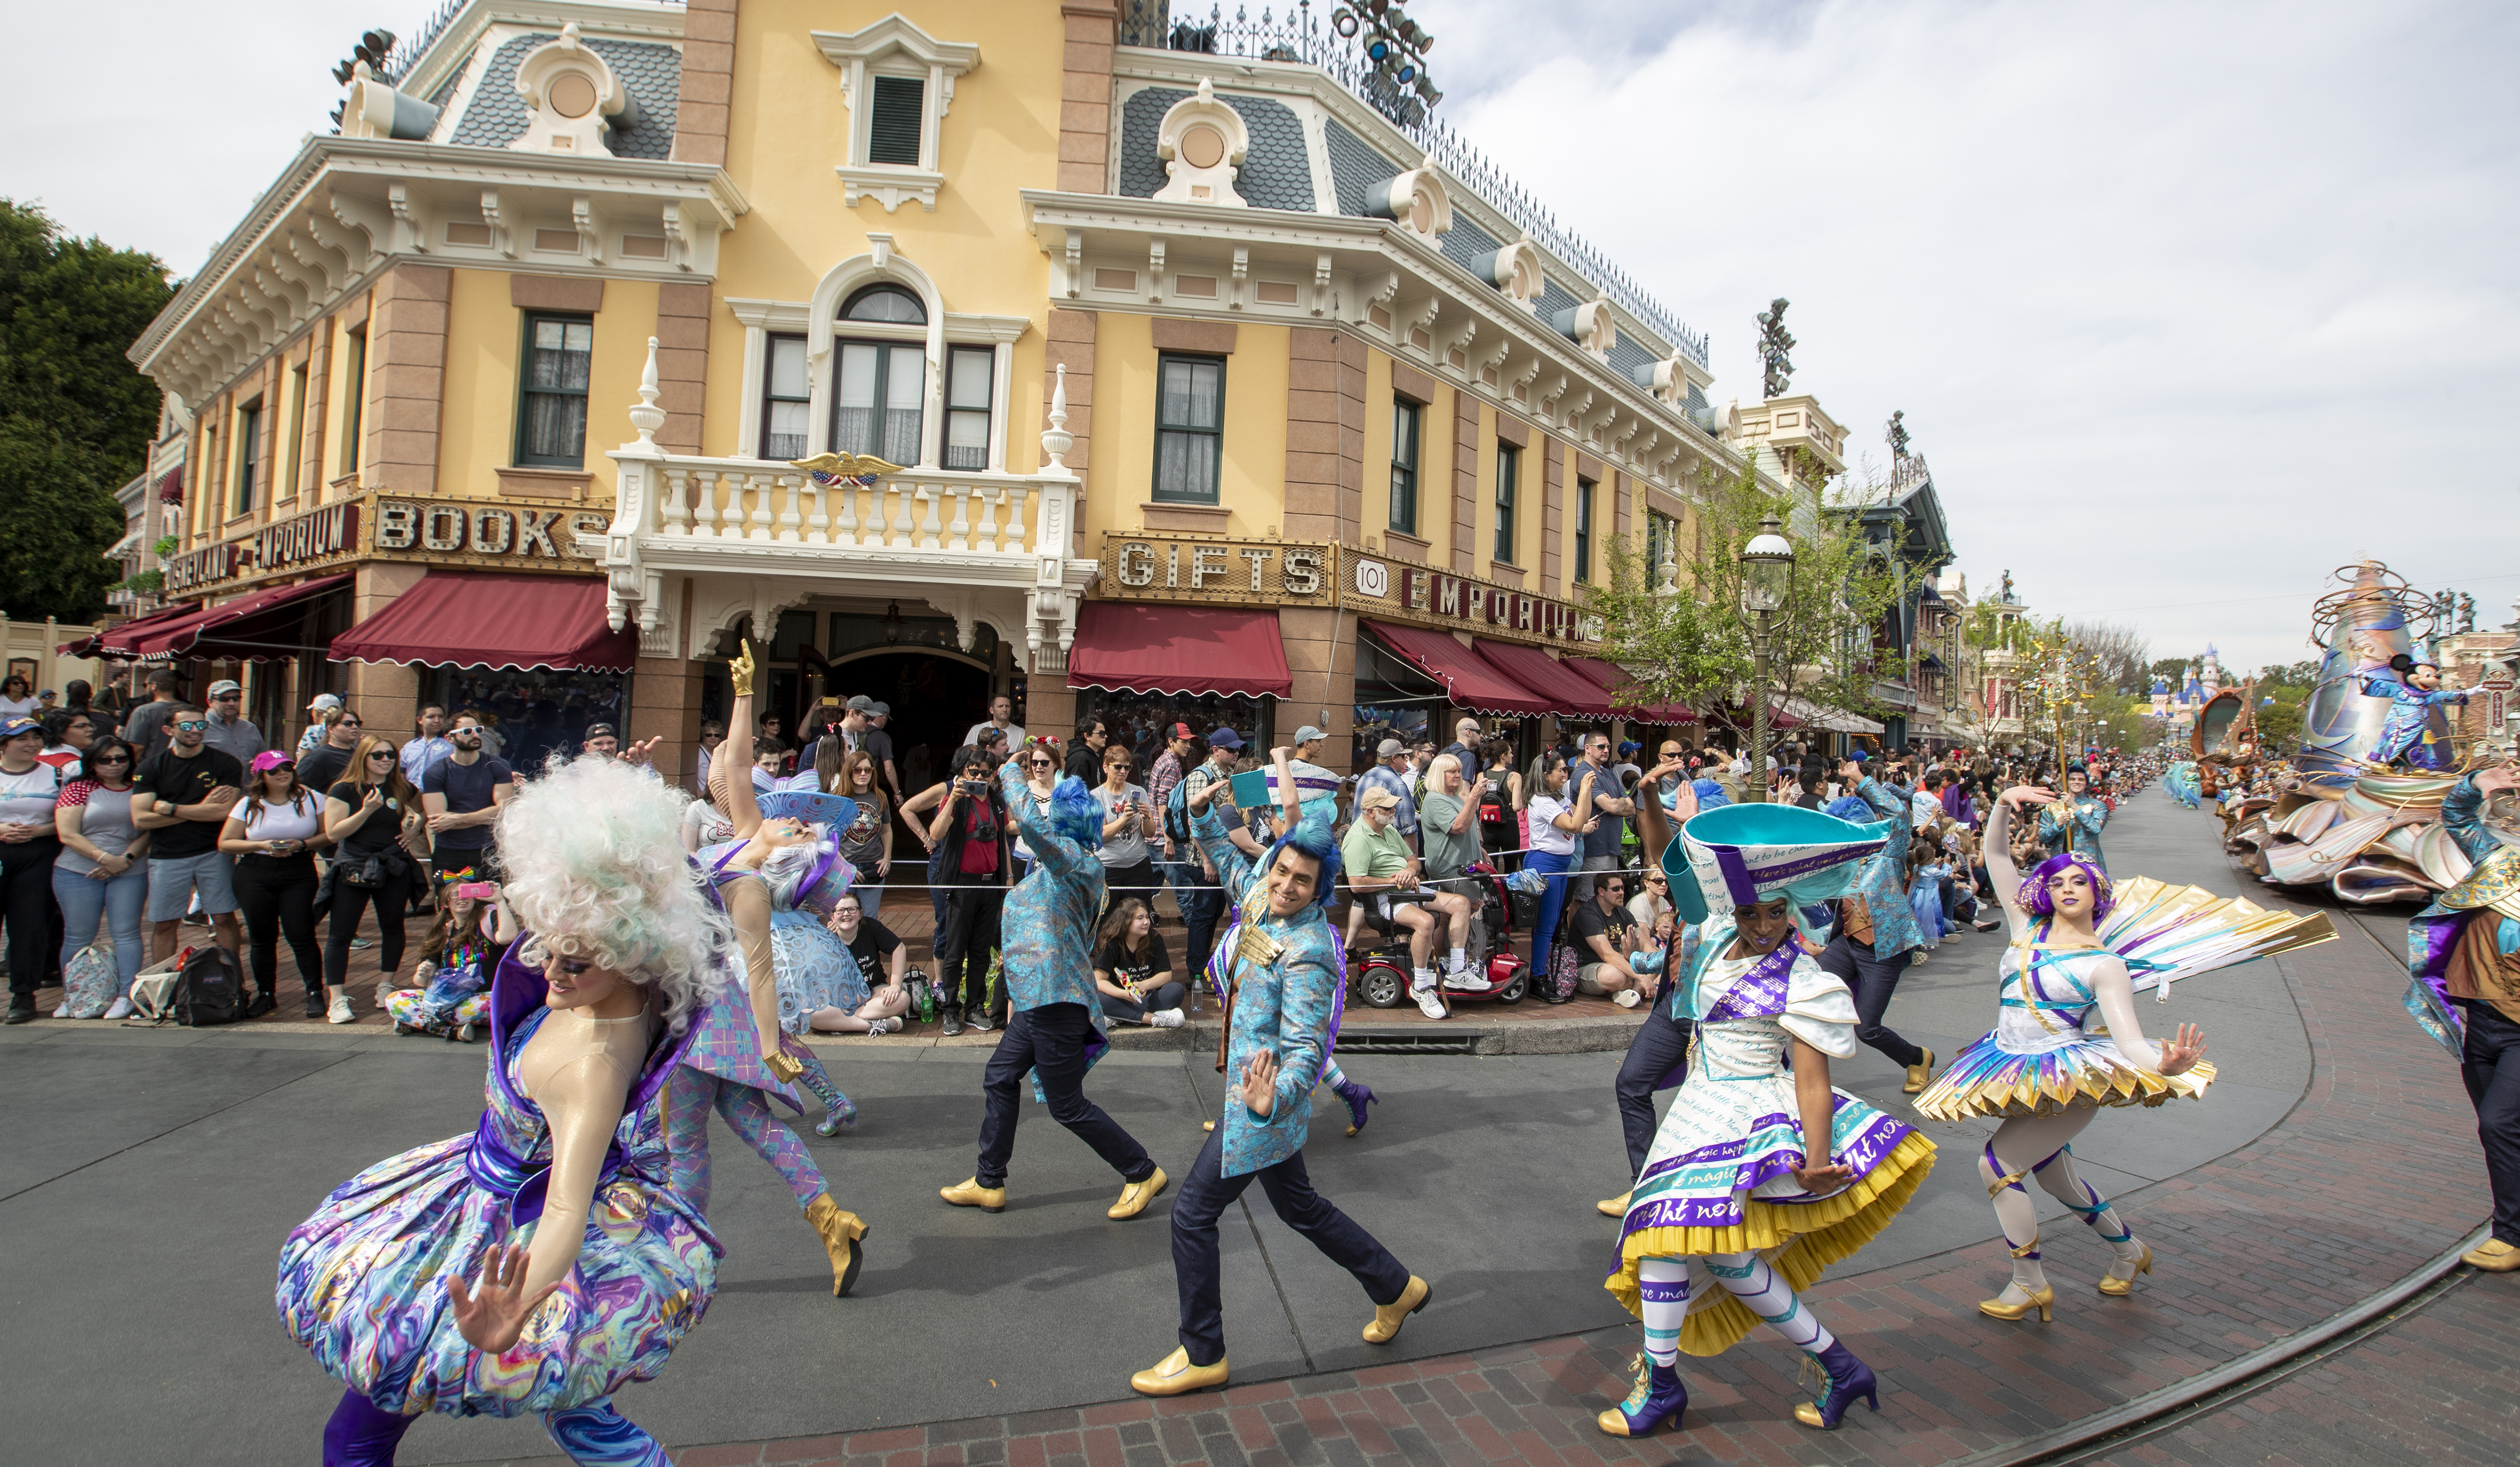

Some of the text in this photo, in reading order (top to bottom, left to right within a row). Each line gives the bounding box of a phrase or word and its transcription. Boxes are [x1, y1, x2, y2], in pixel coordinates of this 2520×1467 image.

[253, 503, 346, 570] EMPORIUM
[375, 501, 609, 558] BOOKS
[1118, 542, 1320, 593] GIFTS
[1360, 566, 1385, 591] 101
[1403, 567, 1587, 642] EMPORIUM
[1762, 852, 1772, 861] to
[1774, 849, 1786, 858] be
[1753, 867, 1786, 879] Here's
[1789, 863, 1814, 874] what
[1814, 857, 1835, 869] you
[858, 955, 870, 964] ONE
[1709, 1091, 1730, 1106] little
[1677, 1115, 1692, 1126] come
[1692, 1123, 1710, 1135] true
[1687, 1167, 1737, 1187] magic
[1633, 1199, 1689, 1228] right
